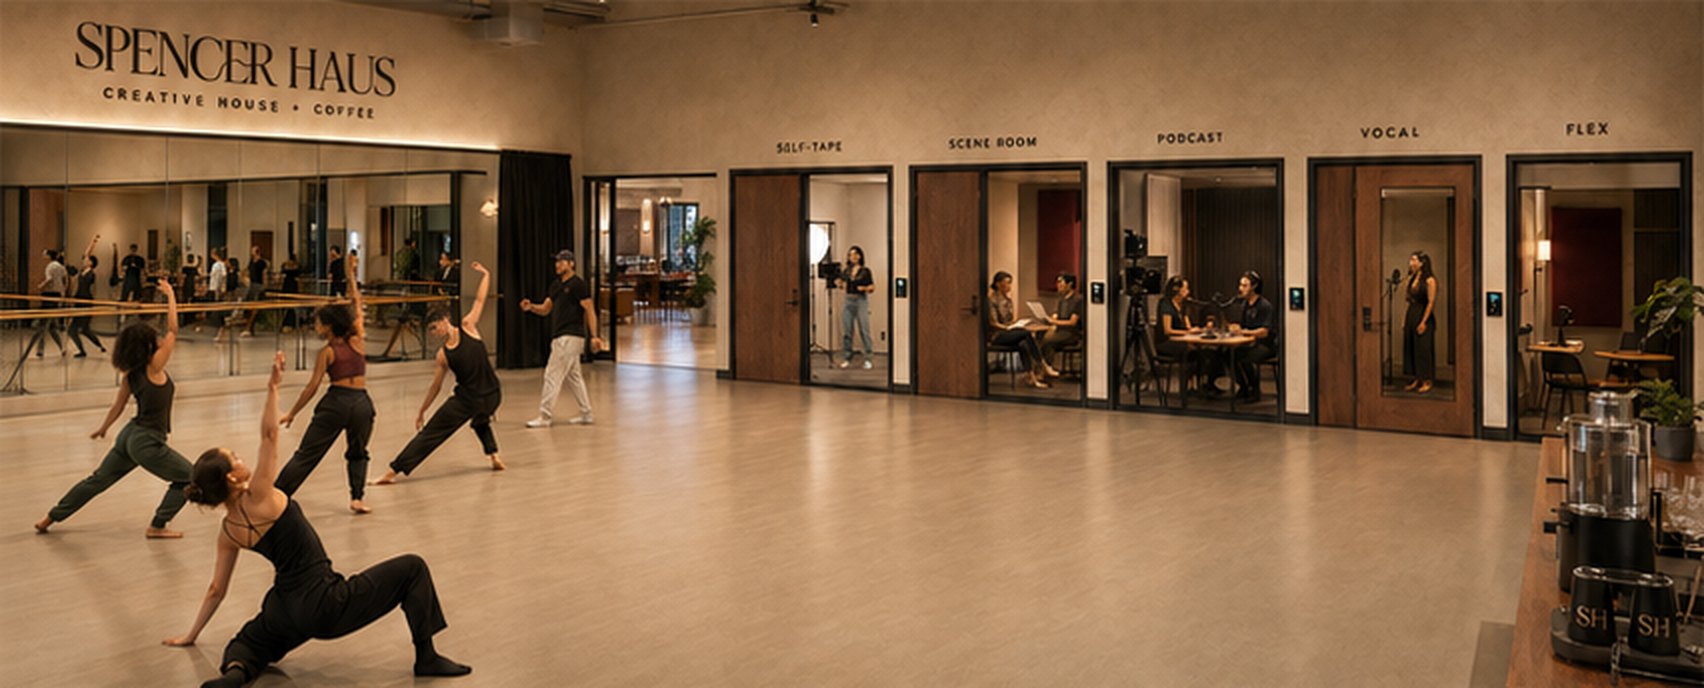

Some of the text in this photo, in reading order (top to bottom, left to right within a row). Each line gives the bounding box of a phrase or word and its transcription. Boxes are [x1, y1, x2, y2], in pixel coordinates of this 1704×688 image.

[75, 21, 396, 97] SPENCER HAUS
[103, 87, 375, 119] CREATIVE HOUSE COFFEE
[1157, 132, 1222, 144] PODCAST
[1360, 126, 1420, 139] VOCAL
[1566, 122, 1609, 136] FLEX
[948, 137, 990, 149] SCENE
[1575, 605, 1608, 630] SH
[1637, 613, 1671, 639] SH
